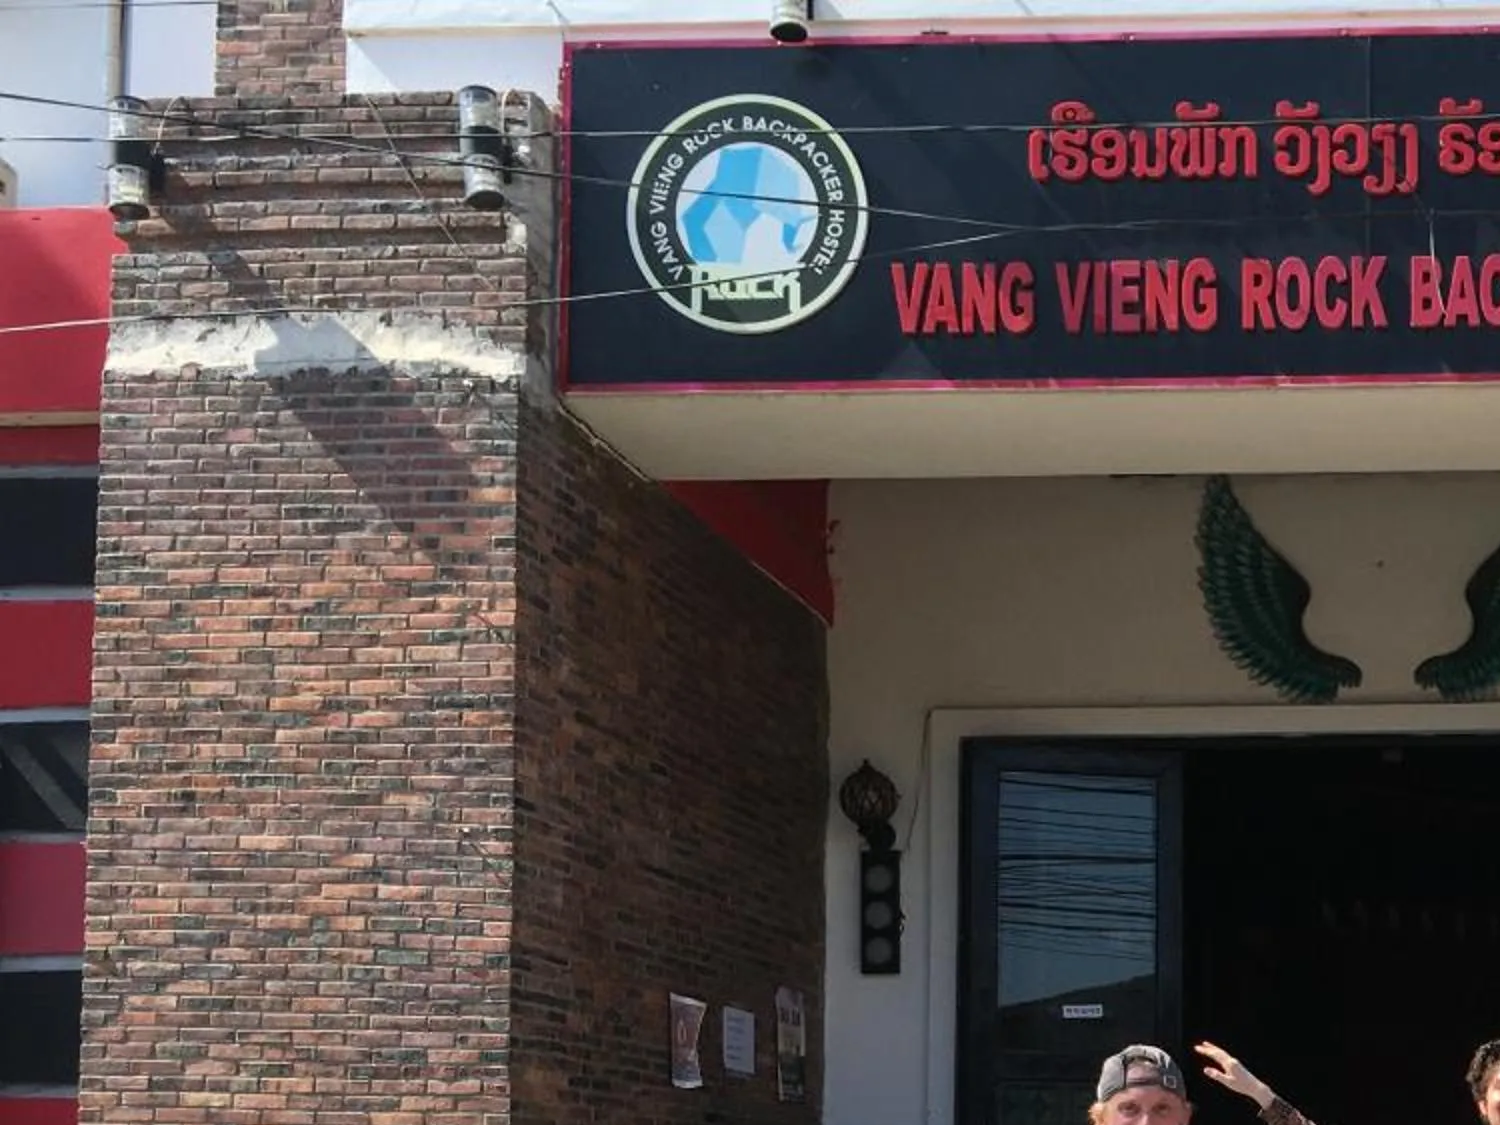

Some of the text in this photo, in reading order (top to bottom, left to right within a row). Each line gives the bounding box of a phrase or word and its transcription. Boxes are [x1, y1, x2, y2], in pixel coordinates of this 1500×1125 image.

[682, 117, 735, 154] ROCK
[742, 115, 844, 203] BACKPACKER
[650, 153, 685, 214] VIENG
[651, 221, 683, 281] VANG
[890, 260, 1036, 334] VANG
[1055, 257, 1218, 333] VIENG
[1240, 254, 1389, 331] ROCK
